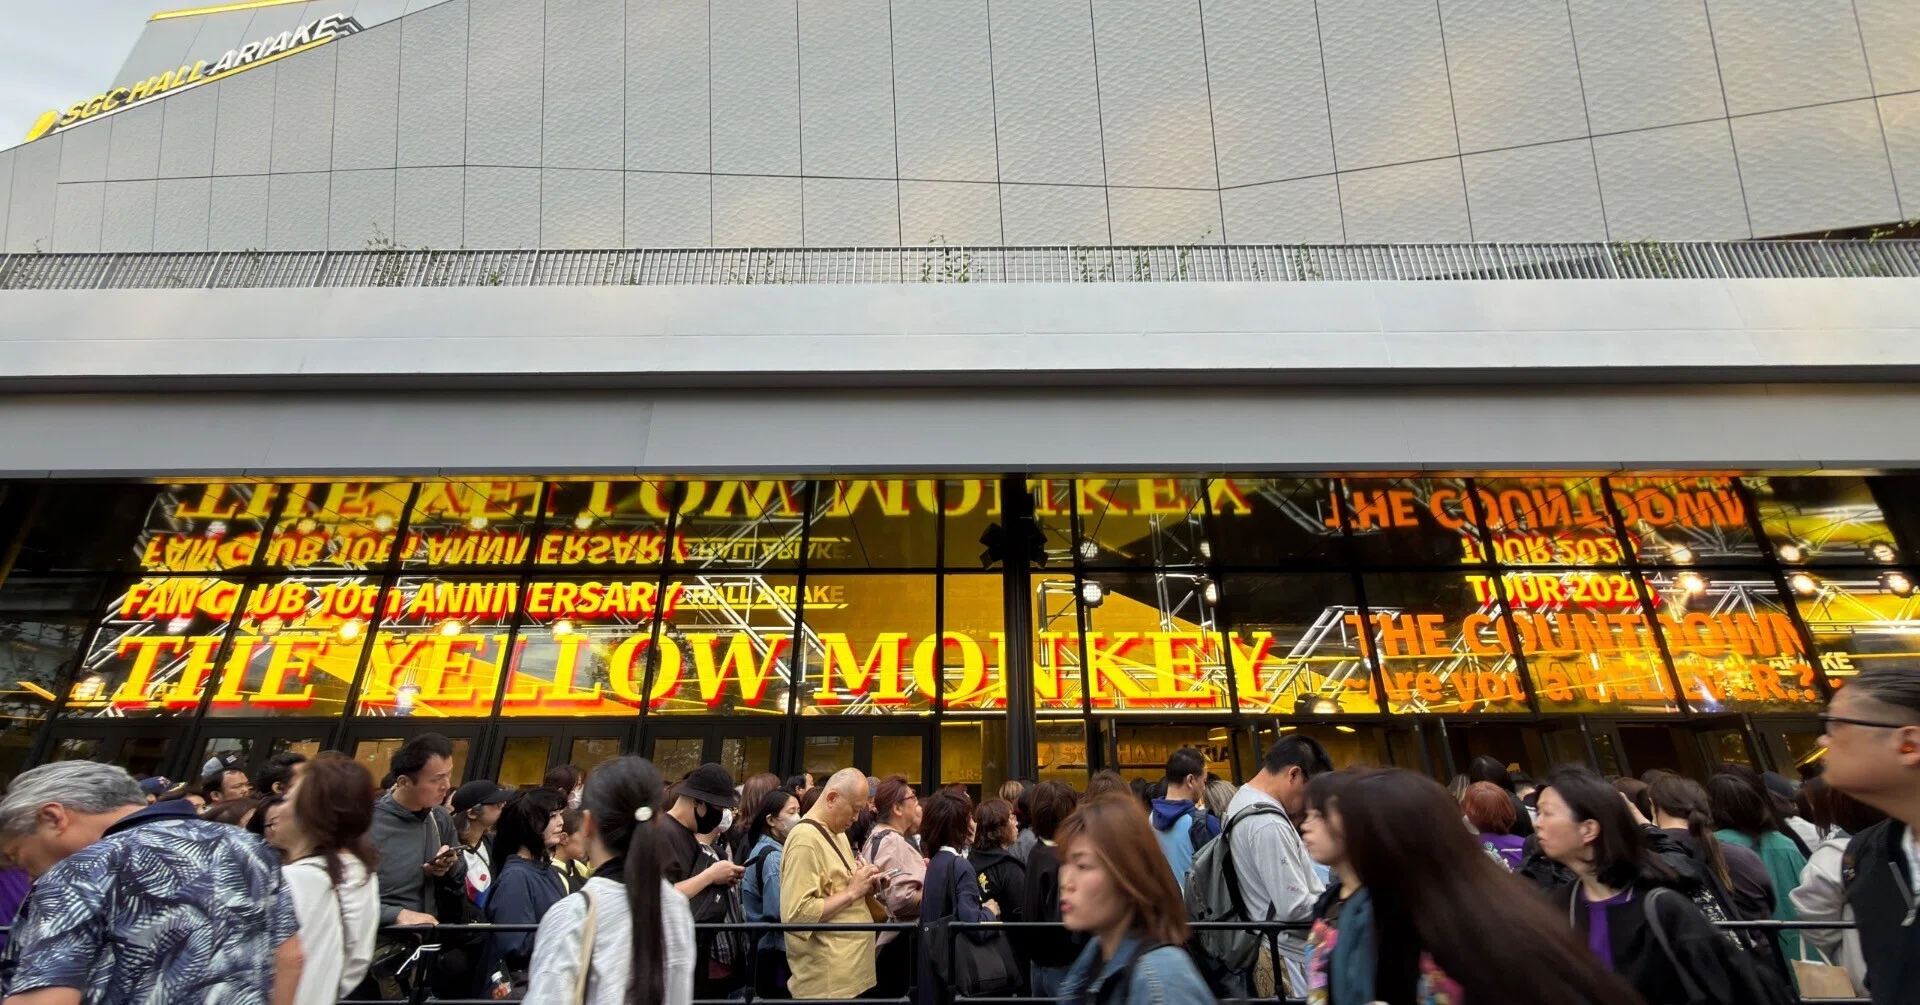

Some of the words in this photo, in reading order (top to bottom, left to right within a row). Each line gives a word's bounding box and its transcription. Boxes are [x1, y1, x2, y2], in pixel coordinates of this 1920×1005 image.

[61, 87, 127, 126] SGC
[125, 59, 209, 104] HALL
[209, 12, 346, 75] ARIAKE
[120, 582, 200, 615] FAN
[408, 580, 683, 615] ANNIVERSARY
[1465, 575, 1565, 604] TOUR
[1344, 613, 1452, 657] THE
[1462, 612, 1807, 657] COUNTDOWN
[115, 635, 328, 703] THE
[358, 632, 790, 706] YELLOW
[813, 630, 1274, 702] MONKEY
